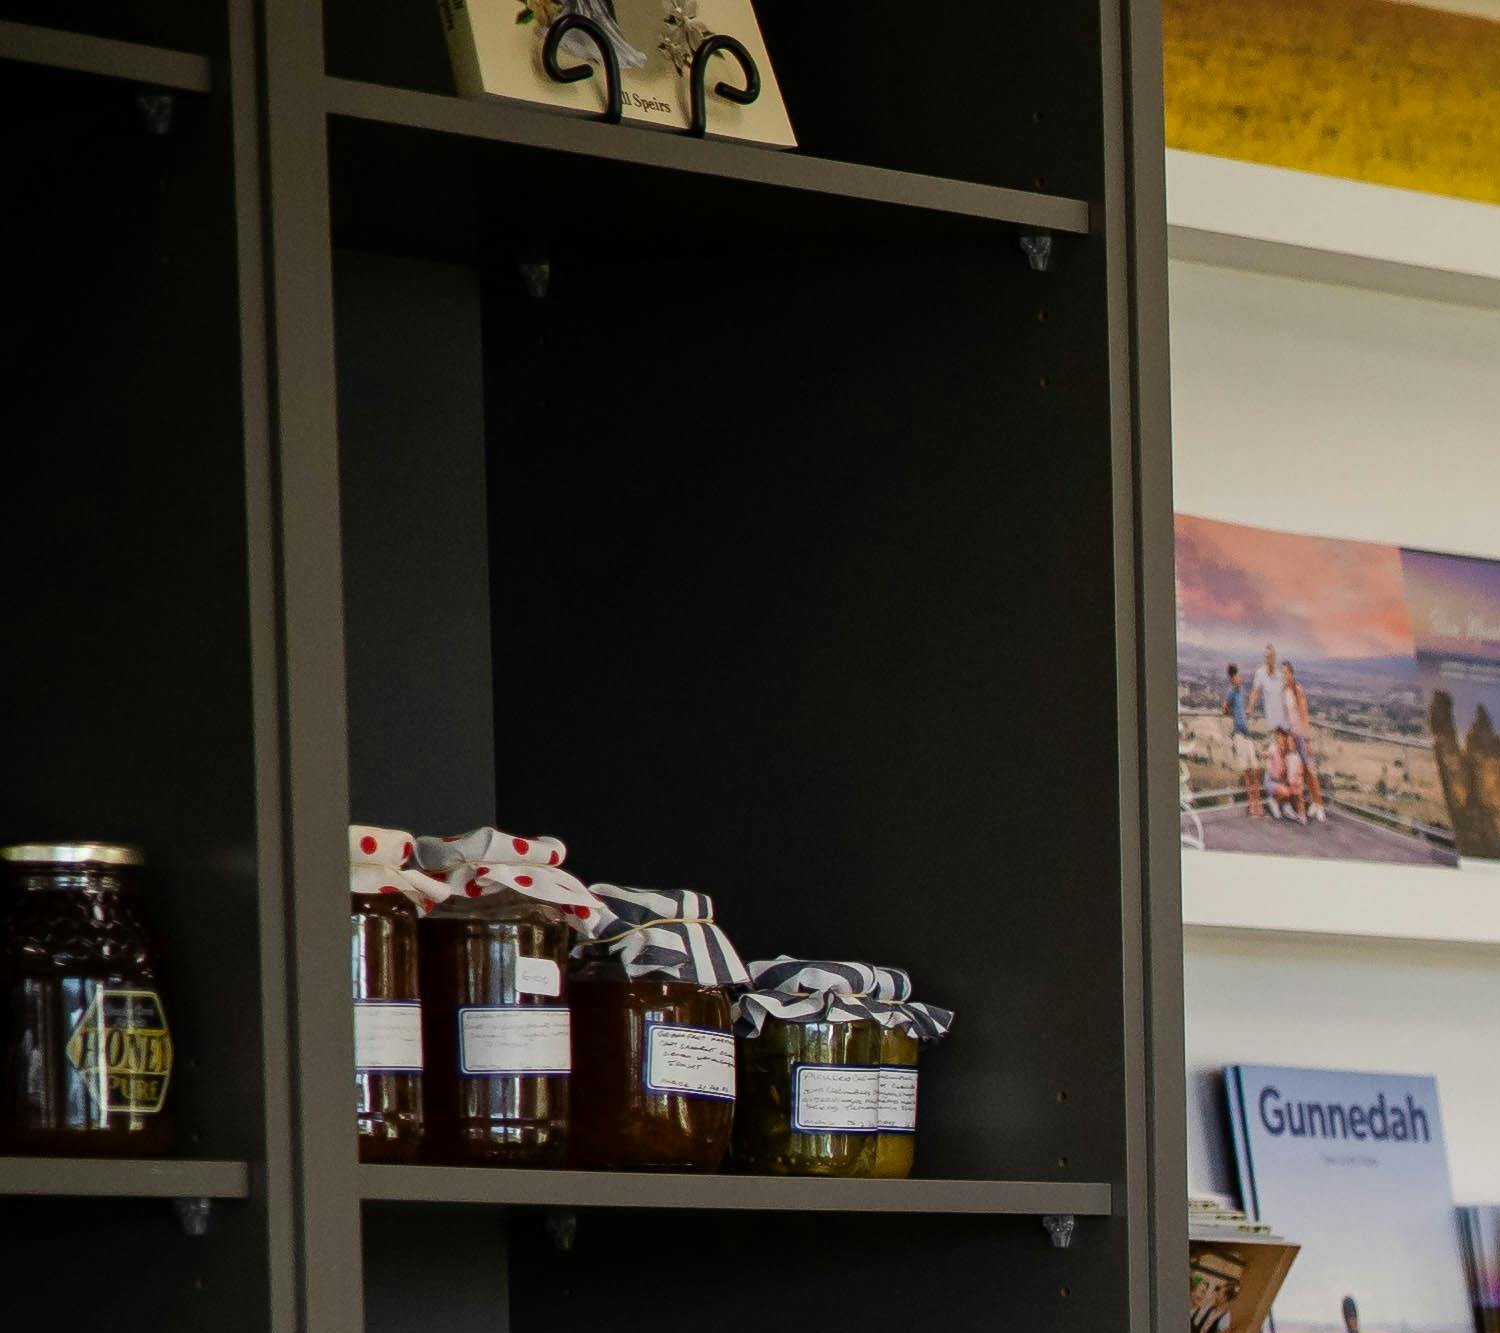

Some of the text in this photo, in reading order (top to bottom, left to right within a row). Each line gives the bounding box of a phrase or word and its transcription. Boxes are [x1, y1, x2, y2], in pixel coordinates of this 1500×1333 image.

[632, 93, 671, 113] Speirs
[80, 1028, 171, 1074] HONEY
[1258, 1084, 1433, 1143] Gunnedah
